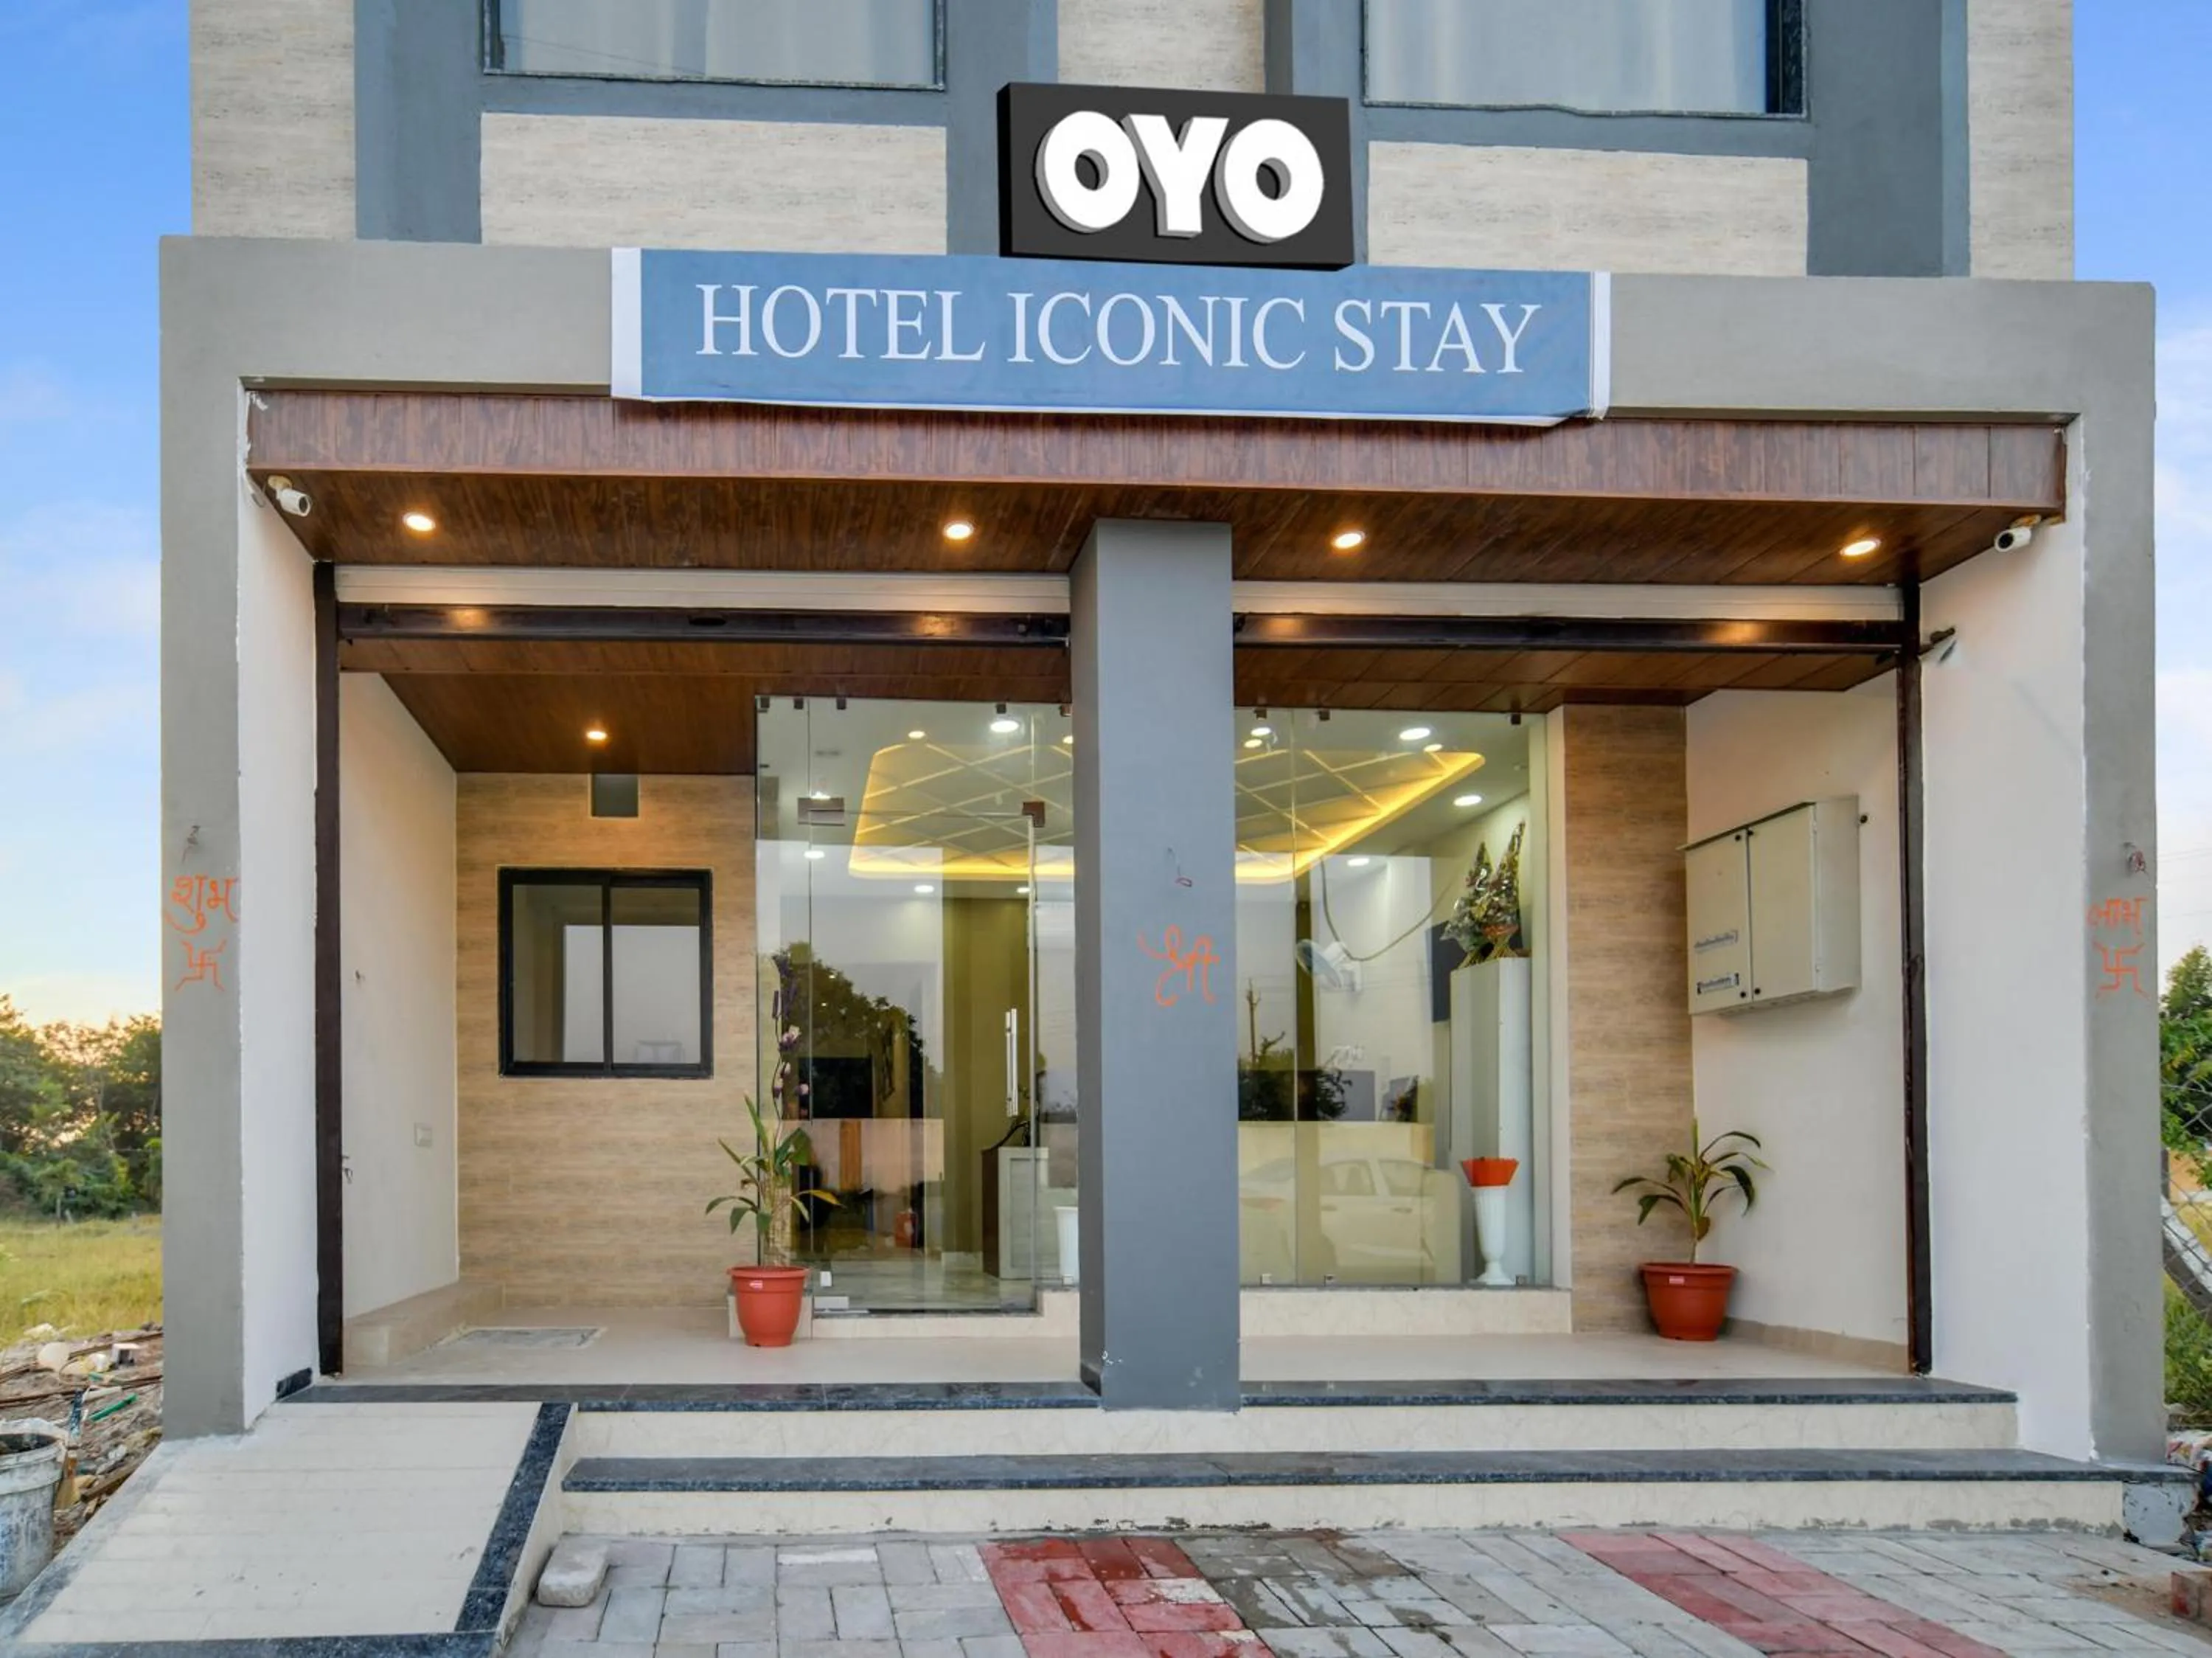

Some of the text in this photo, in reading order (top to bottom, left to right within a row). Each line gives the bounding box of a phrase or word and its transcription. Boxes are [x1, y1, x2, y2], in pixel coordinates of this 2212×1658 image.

[1035, 110, 1325, 244] OYO
[695, 284, 1543, 374] HOTEL ICONIC STAY
